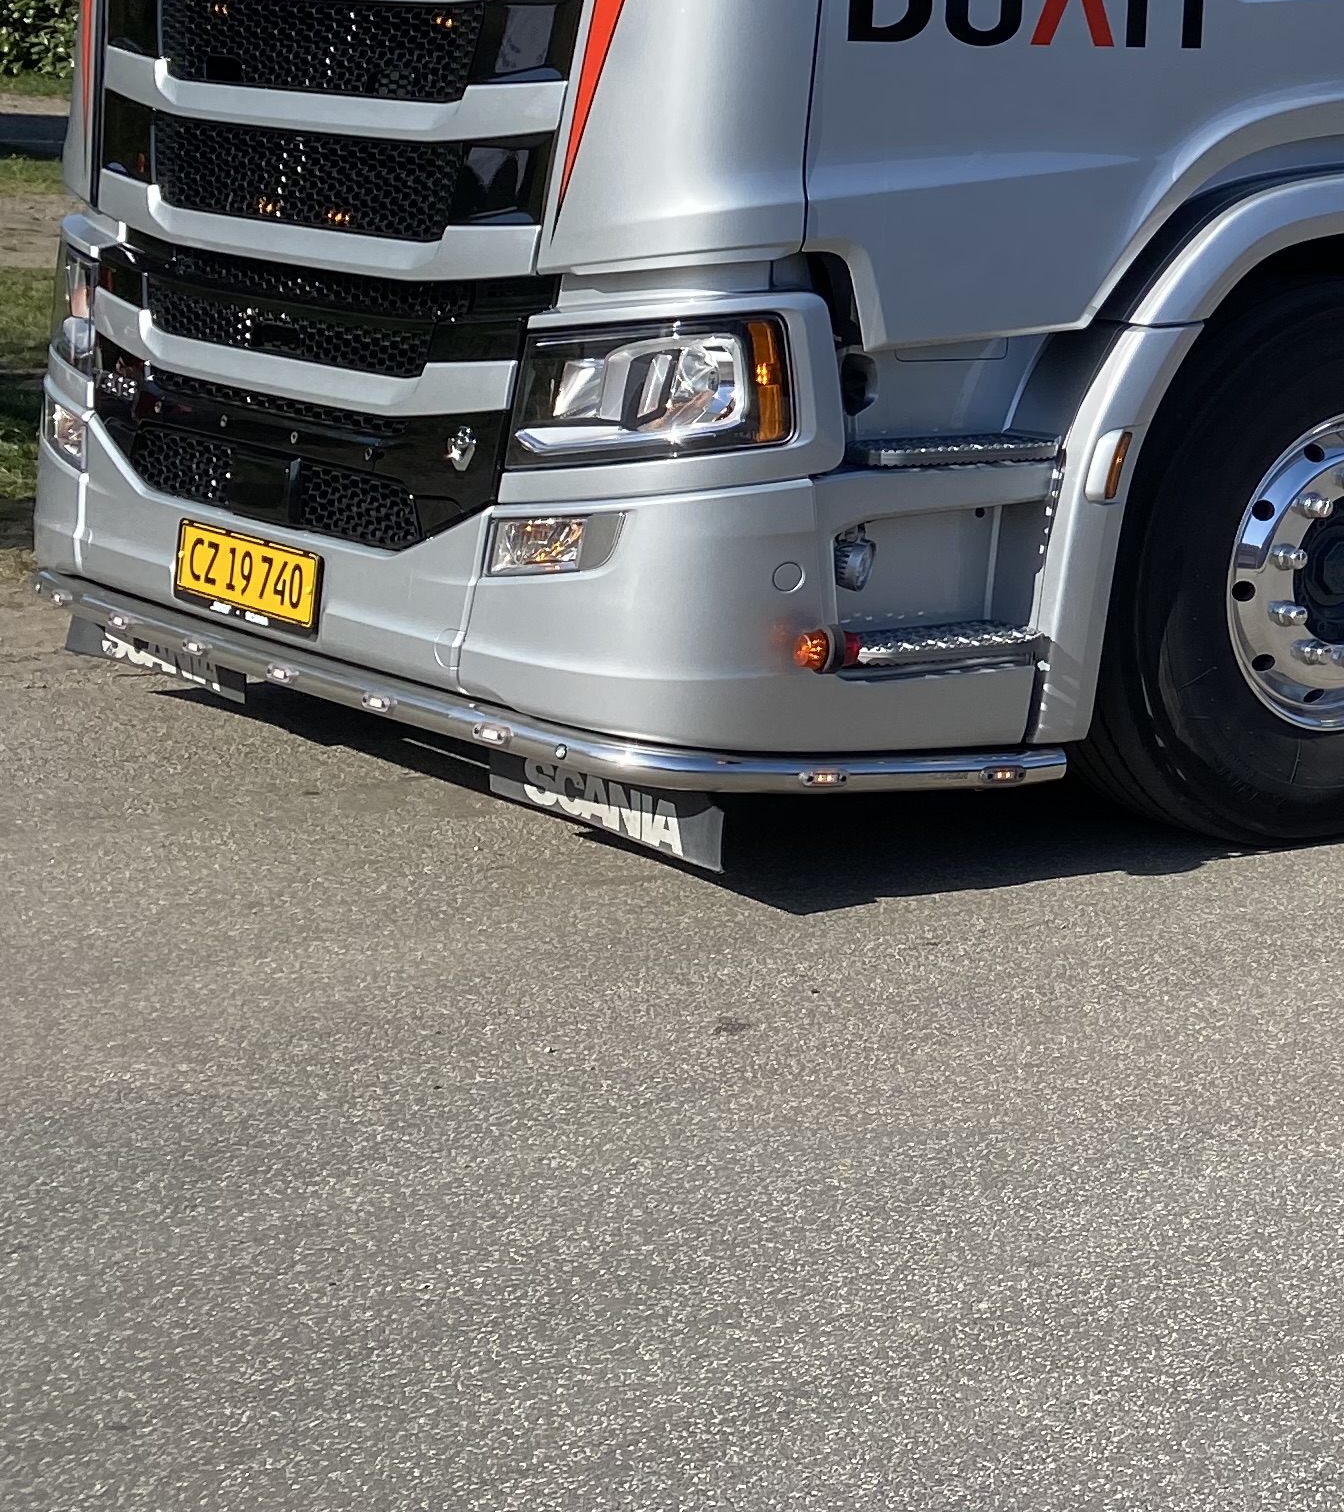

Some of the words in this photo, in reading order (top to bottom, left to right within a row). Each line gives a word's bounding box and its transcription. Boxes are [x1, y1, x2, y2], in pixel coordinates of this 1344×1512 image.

[188, 537, 218, 586] CZ
[225, 546, 253, 596] 19
[259, 555, 303, 609] 740
[523, 758, 684, 857] SCANIA
